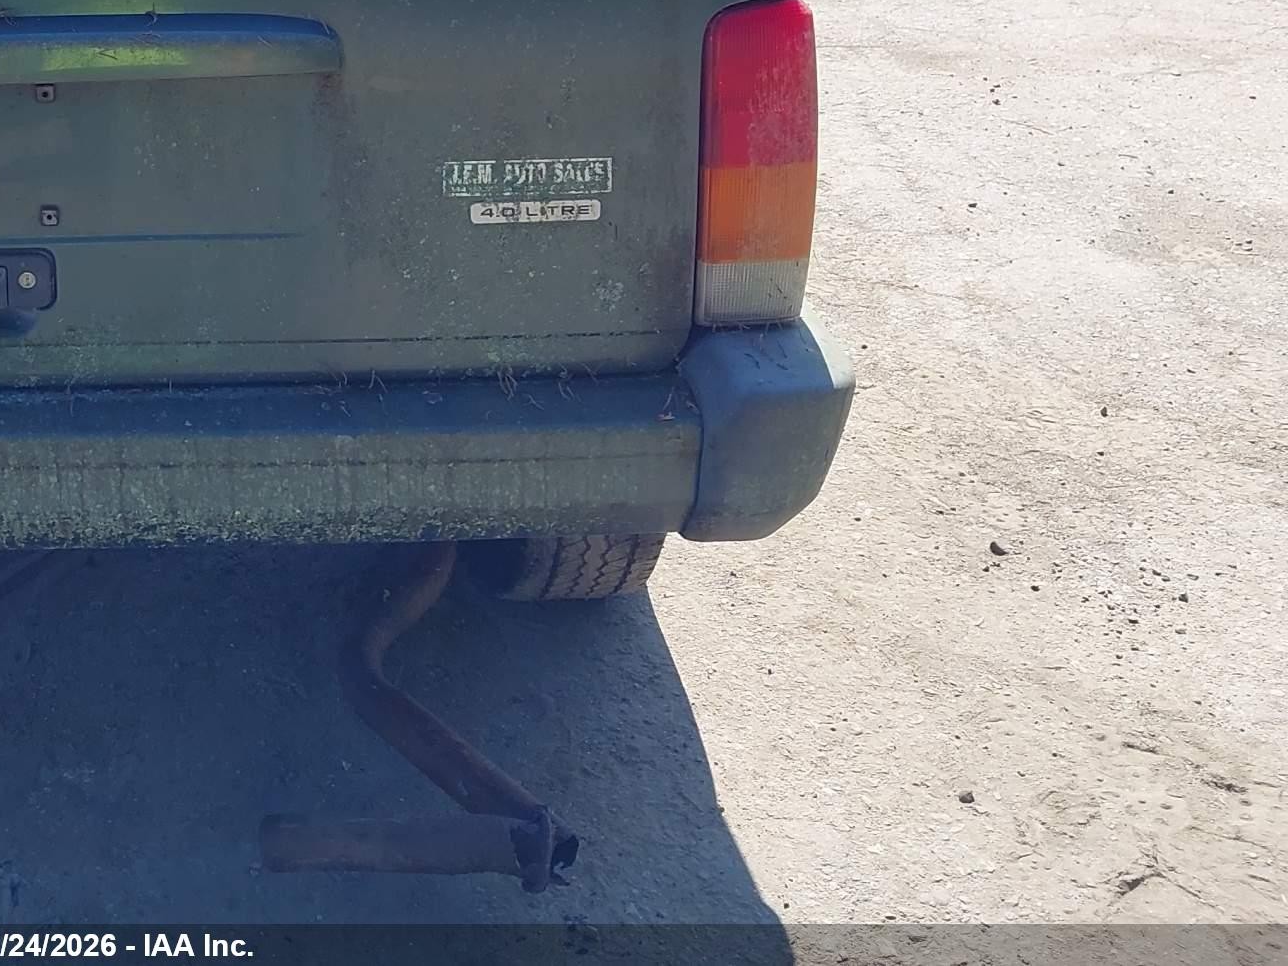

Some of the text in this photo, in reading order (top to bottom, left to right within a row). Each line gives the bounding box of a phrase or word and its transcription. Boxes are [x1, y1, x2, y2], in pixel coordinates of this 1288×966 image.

[504, 162, 547, 185] AUTO
[553, 161, 605, 183] SALES
[480, 205, 593, 218] 4.0 LITRE
